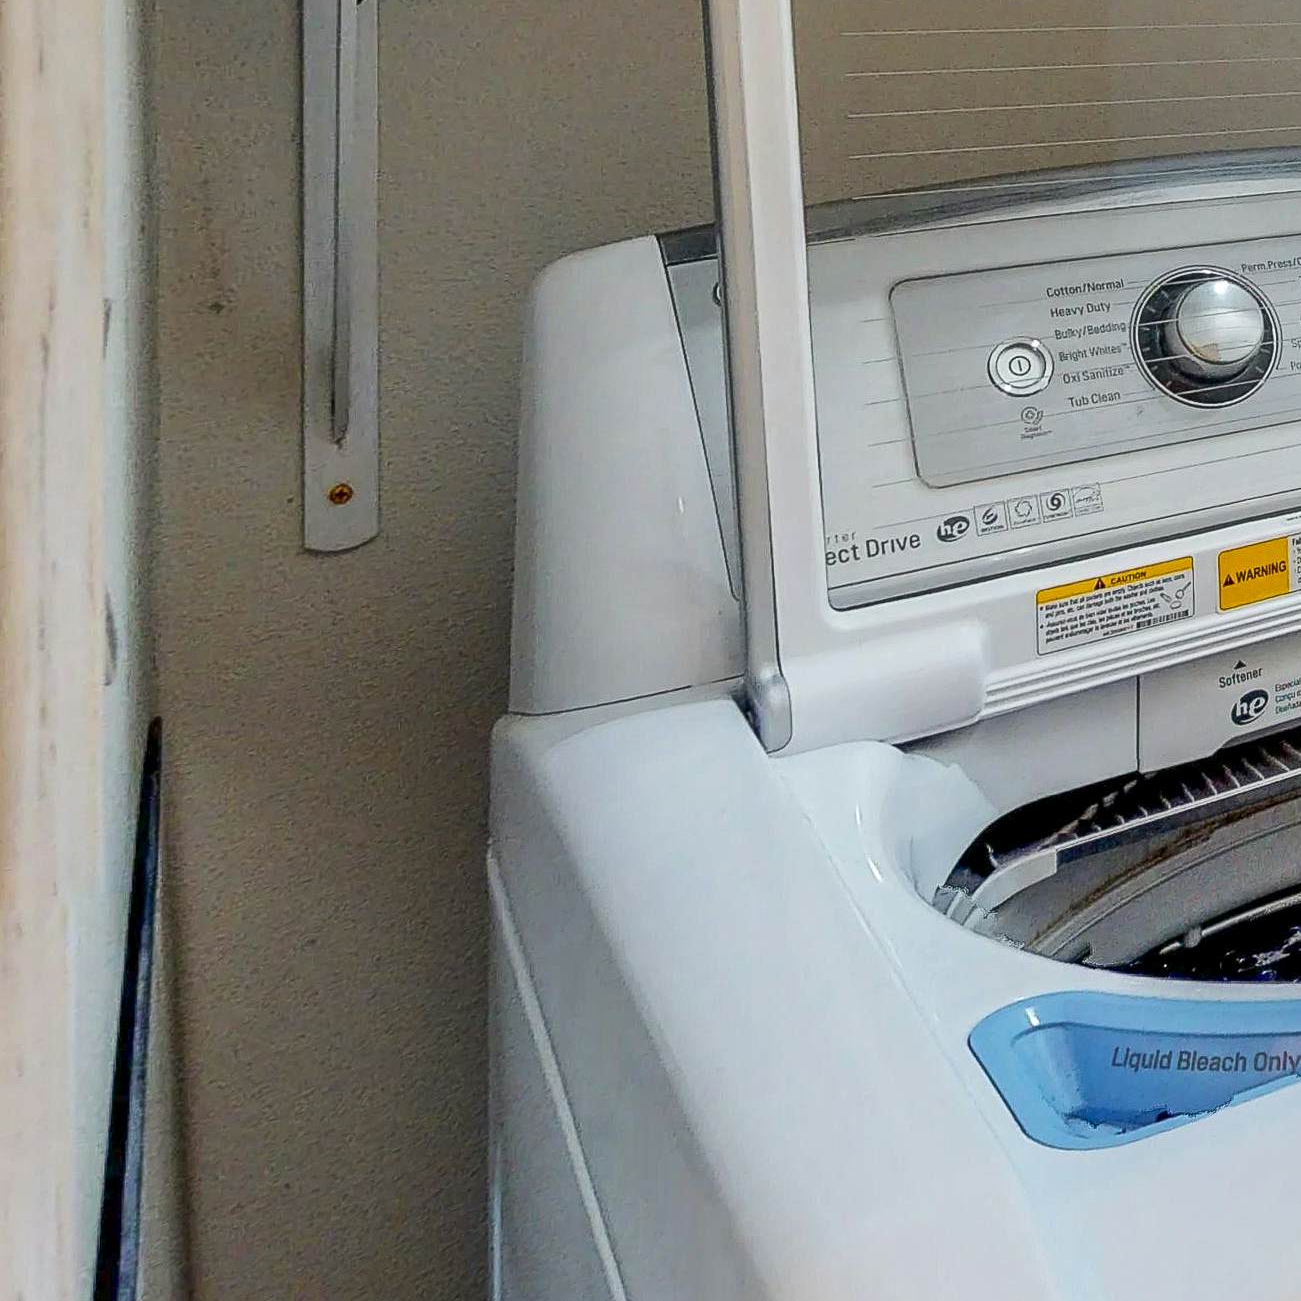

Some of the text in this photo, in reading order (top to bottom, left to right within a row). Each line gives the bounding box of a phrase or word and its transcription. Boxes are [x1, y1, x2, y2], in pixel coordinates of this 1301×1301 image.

[1046, 279, 1124, 298] Cotton/Normal
[1050, 302, 1111, 318] Heavy Duty
[1054, 321, 1126, 340] Bulky/Bedding
[1059, 350, 1088, 361] Bright
[1063, 372, 1081, 384] Oxi
[1068, 391, 1121, 407] Tub Clean
[866, 532, 921, 557] Drive
[1110, 572, 1147, 585] CAUTION
[1236, 561, 1287, 583] WARNING
[1219, 668, 1263, 689] Softener
[1111, 1046, 1301, 1075] Liquid Bleach Only
